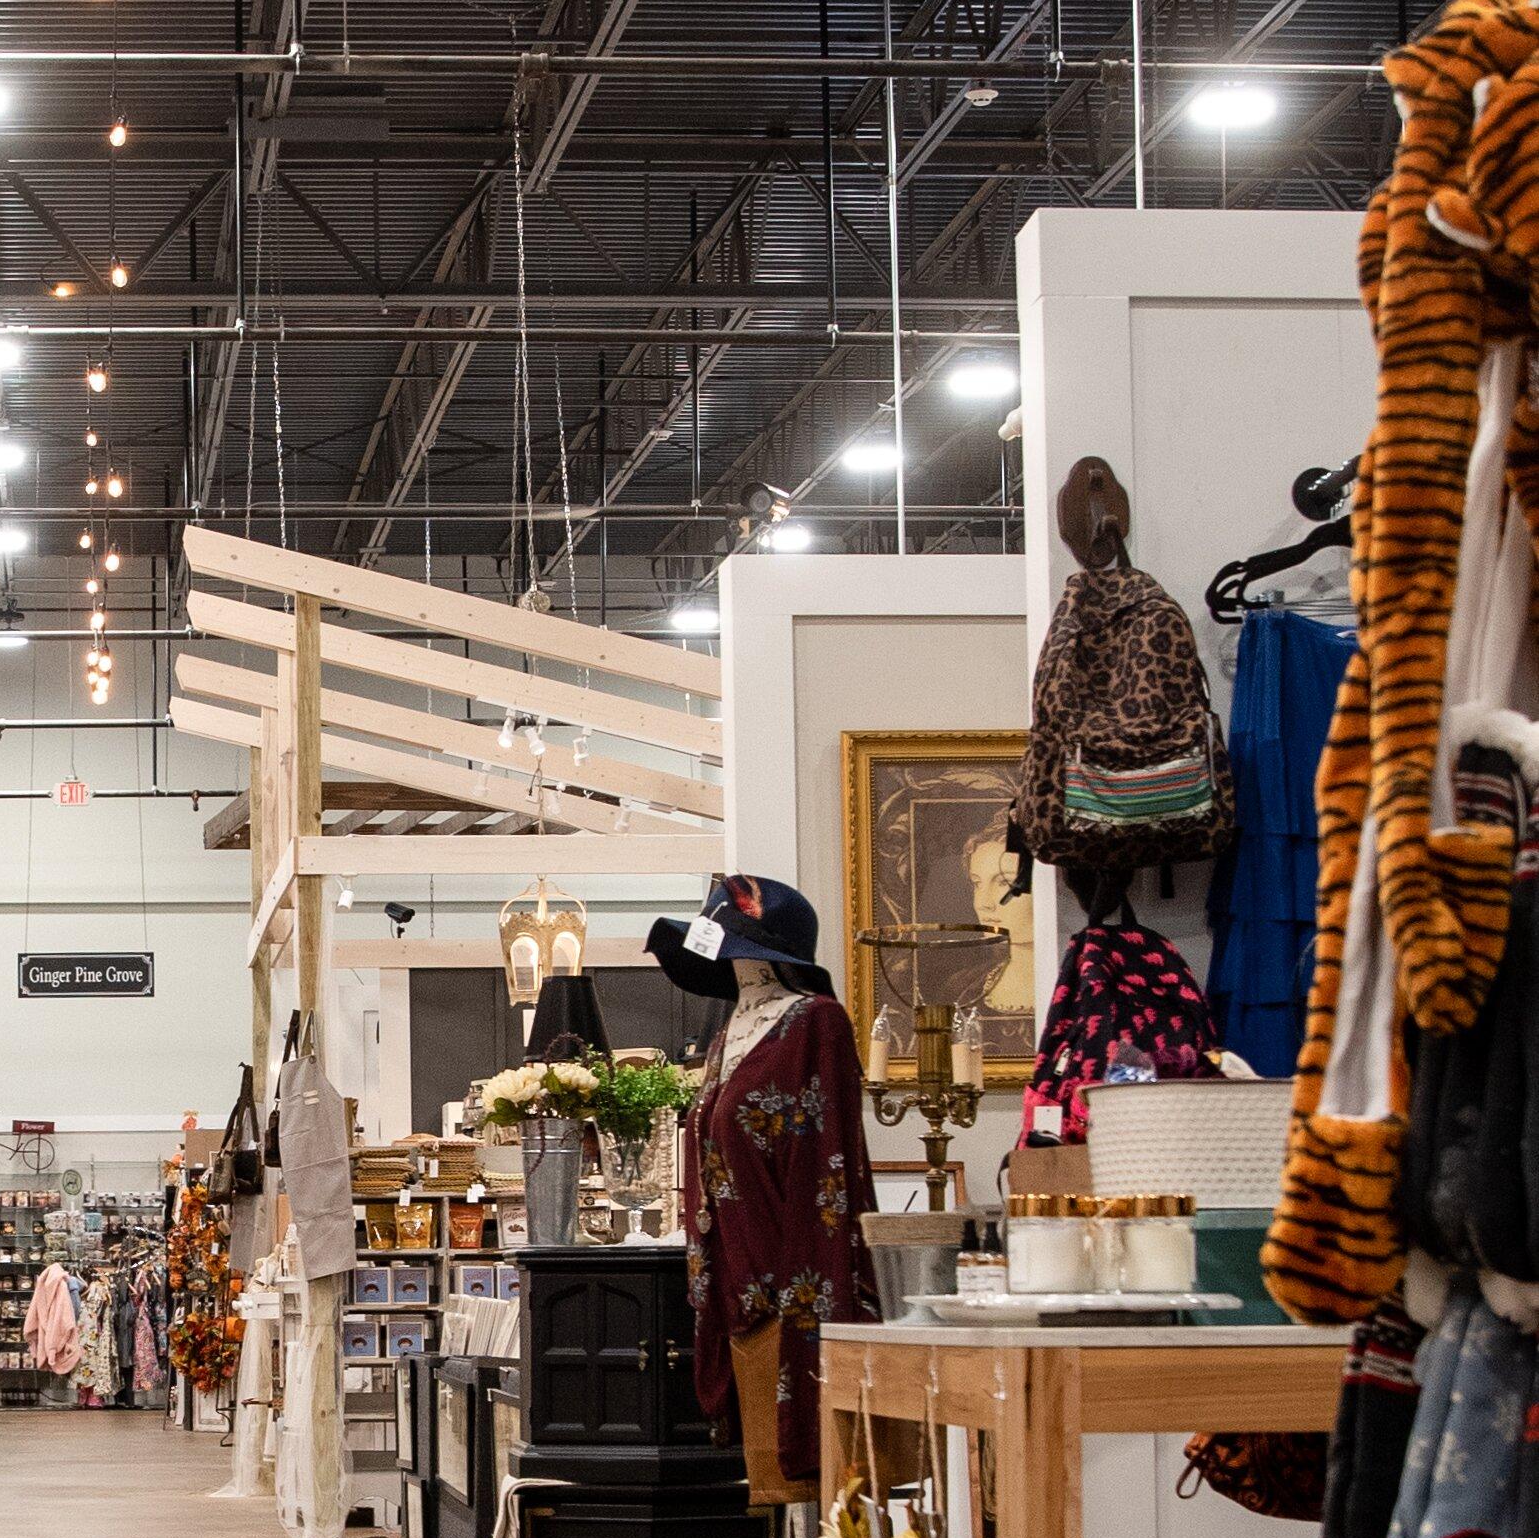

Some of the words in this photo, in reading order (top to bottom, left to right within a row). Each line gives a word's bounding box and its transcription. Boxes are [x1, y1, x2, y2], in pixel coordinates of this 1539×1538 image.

[29, 966, 72, 988] Ginger
[75, 966, 103, 983] Pine
[105, 965, 144, 983] Grove
